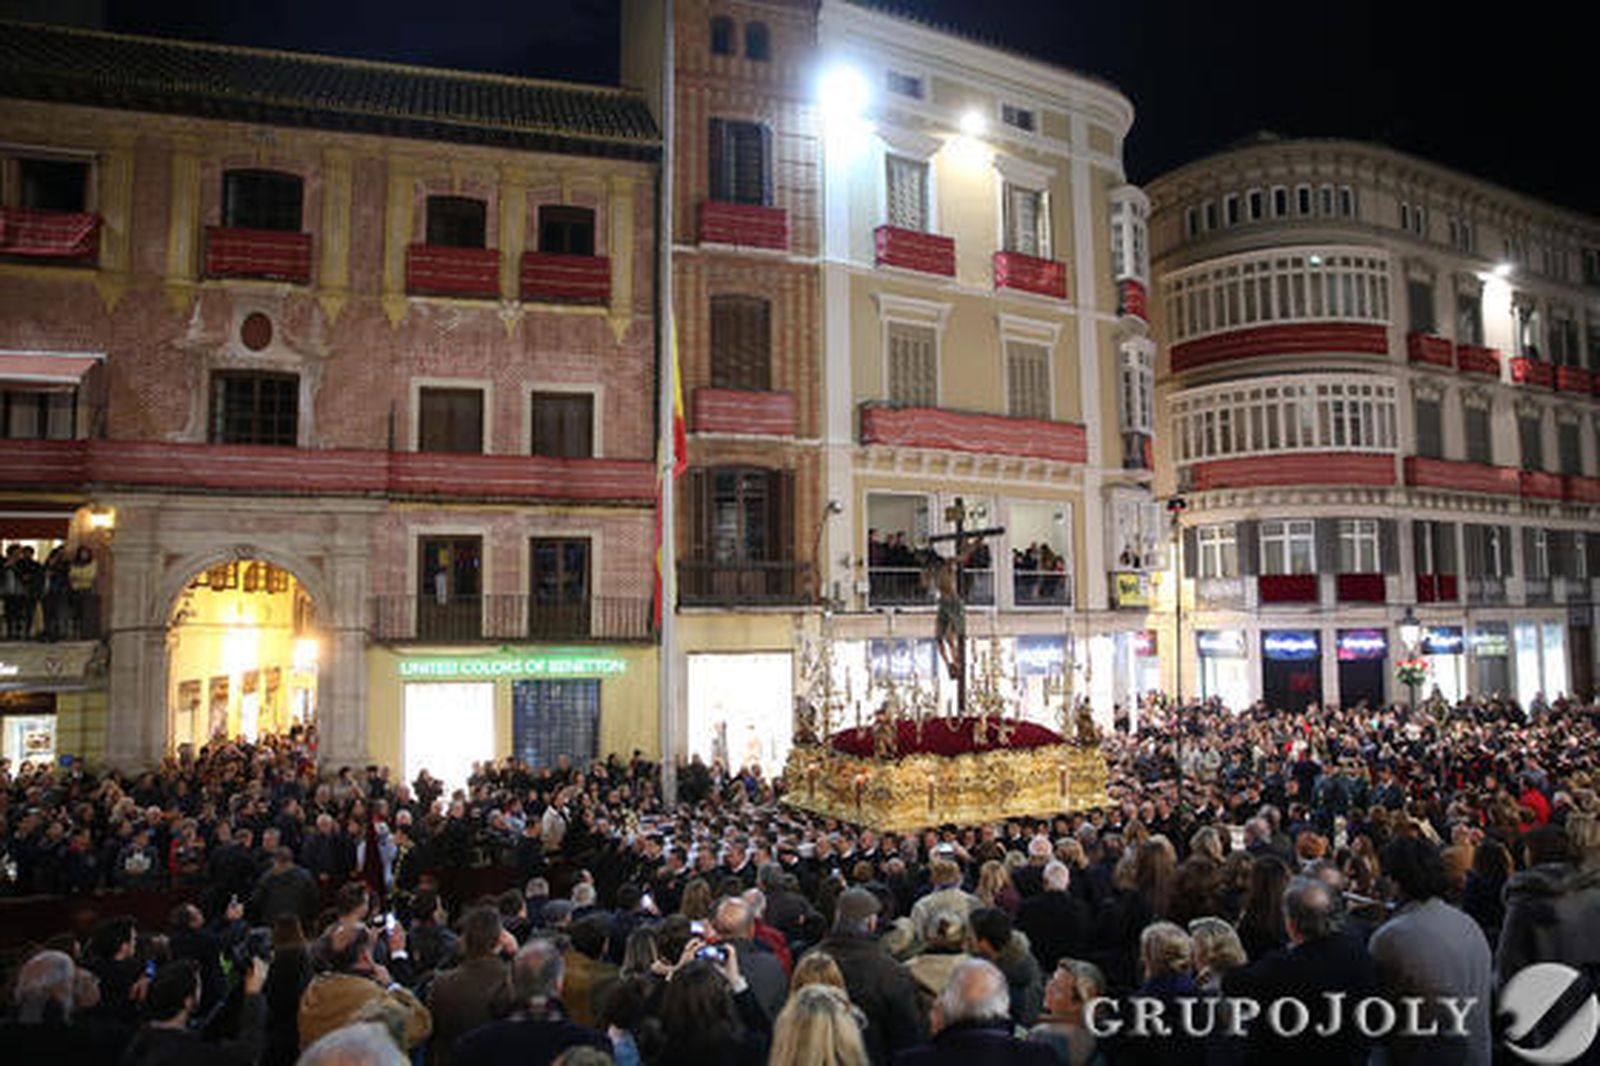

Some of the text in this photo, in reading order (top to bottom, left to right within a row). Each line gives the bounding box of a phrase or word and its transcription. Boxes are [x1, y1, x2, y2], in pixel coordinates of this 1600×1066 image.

[400, 661, 458, 676] UNITED
[461, 660, 523, 675] COLORS
[525, 660, 545, 674] OF
